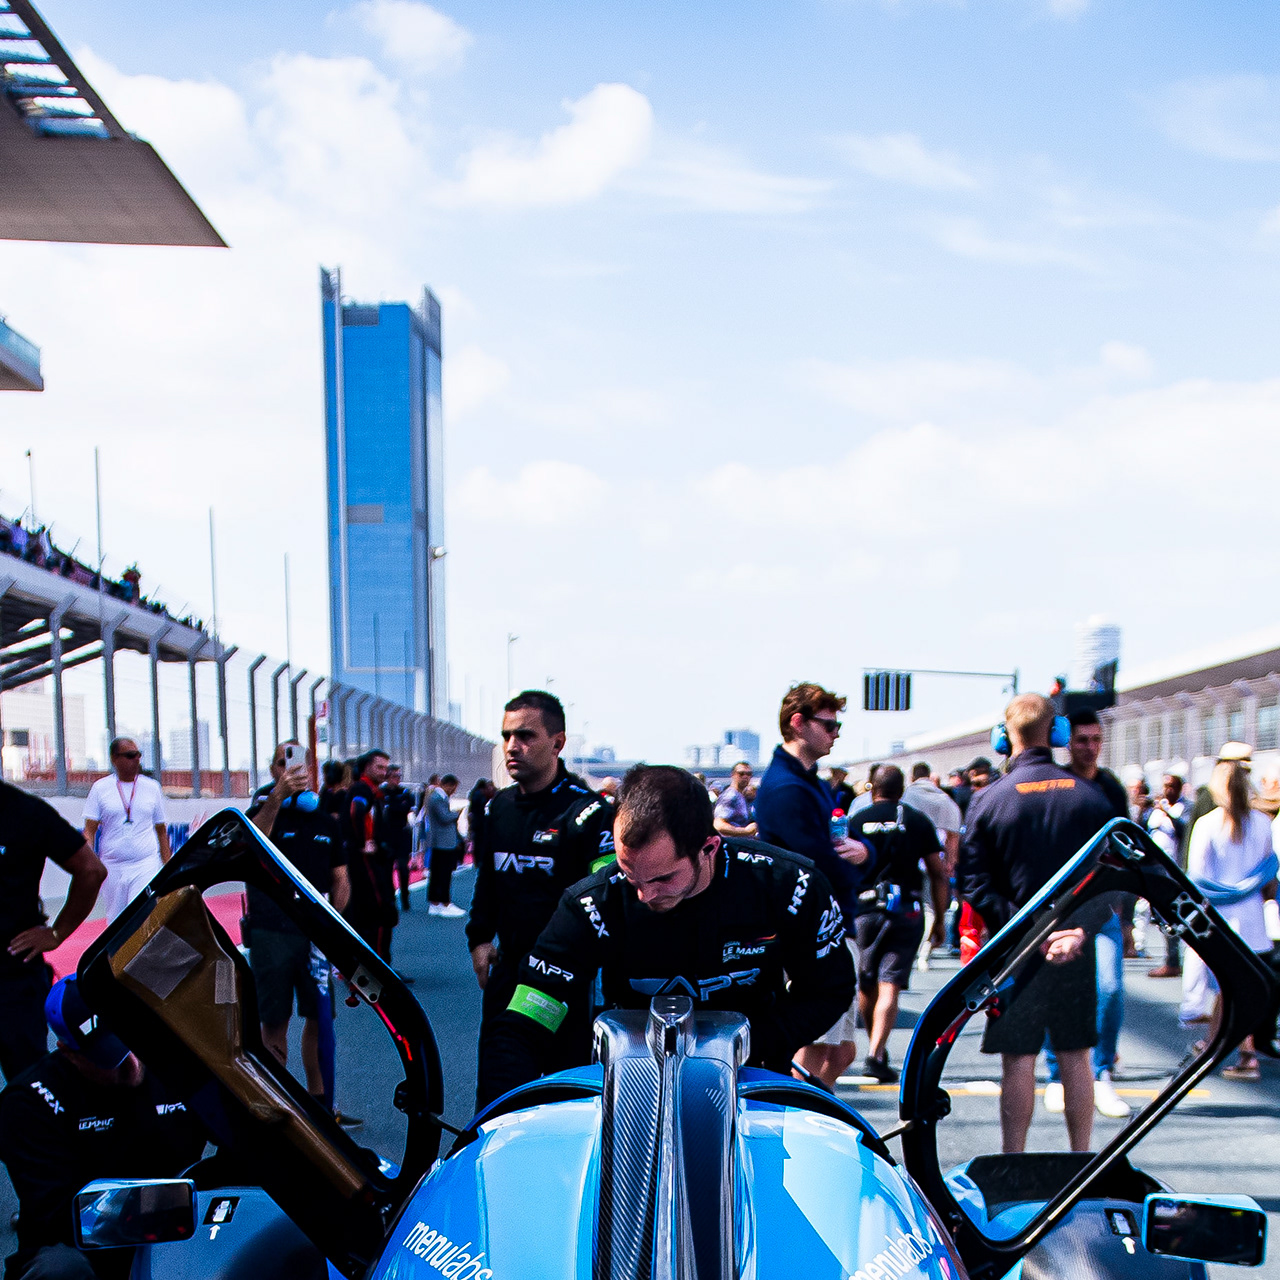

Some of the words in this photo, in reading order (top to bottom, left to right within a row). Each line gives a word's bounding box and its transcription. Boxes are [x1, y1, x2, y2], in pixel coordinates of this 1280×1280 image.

[501, 853, 555, 877] APR
[745, 851, 774, 866] APR
[787, 868, 810, 915] HRX
[580, 896, 610, 938] HRX
[722, 947, 734, 956] LE
[735, 945, 766, 955] MANS
[536, 960, 575, 982] APR
[662, 968, 761, 1001] APR
[30, 1080, 66, 1116] HRX
